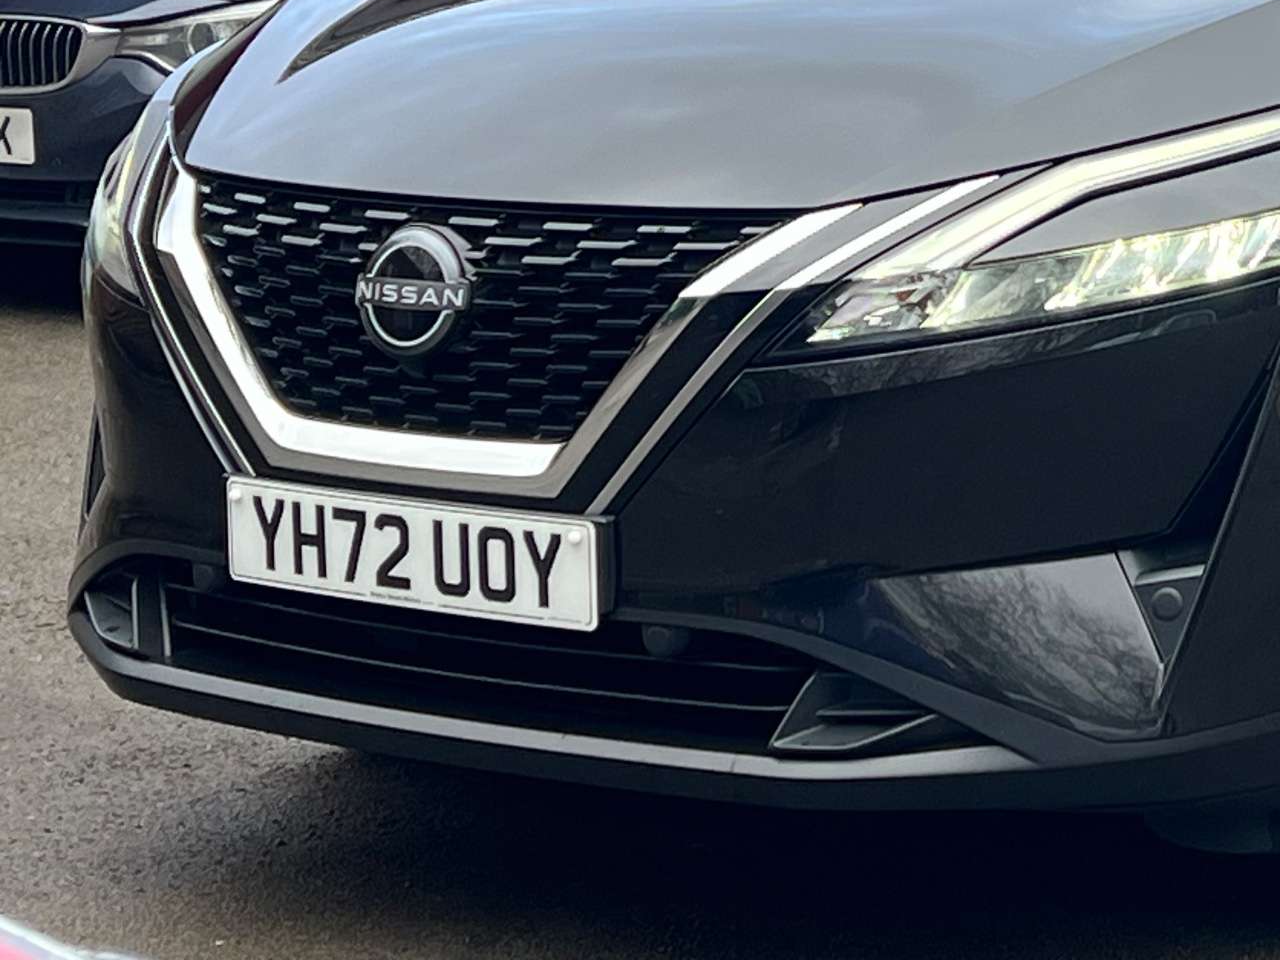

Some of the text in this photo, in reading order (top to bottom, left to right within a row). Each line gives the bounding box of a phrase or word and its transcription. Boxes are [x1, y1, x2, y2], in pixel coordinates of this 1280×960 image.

[359, 281, 464, 307] NISSAN
[253, 495, 562, 609] YH72 UOY
